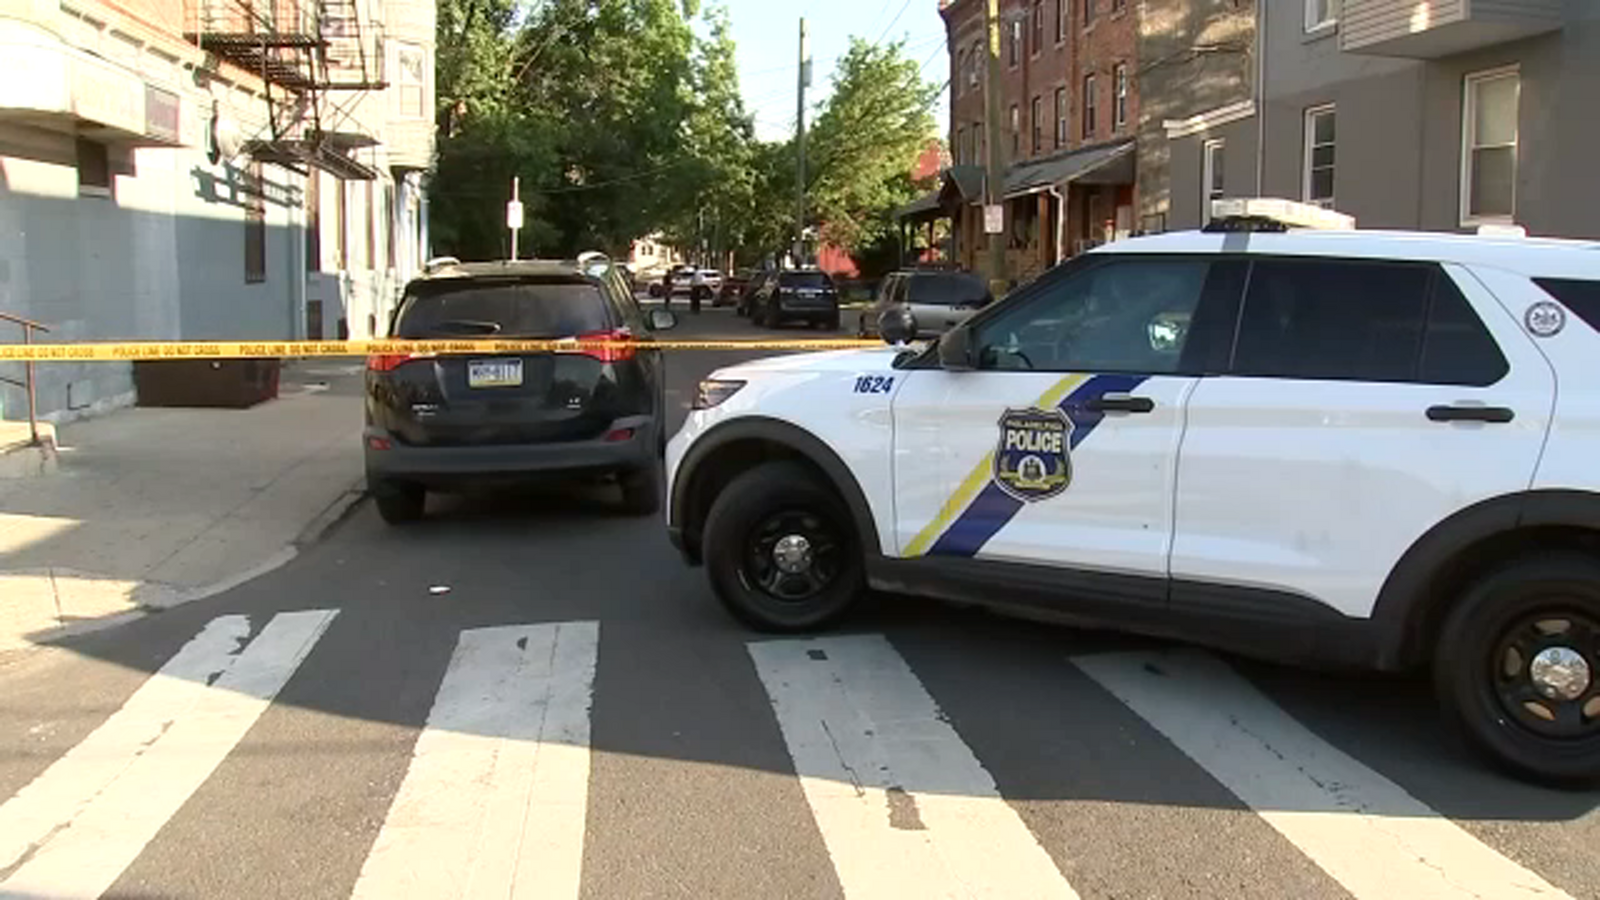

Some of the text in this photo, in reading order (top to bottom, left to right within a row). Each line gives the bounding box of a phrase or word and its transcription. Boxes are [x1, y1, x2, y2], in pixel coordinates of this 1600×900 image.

[177, 345, 191, 355] NOT
[239, 345, 266, 355] POLICE
[269, 345, 286, 355] LINE
[303, 344, 318, 353] NOT
[853, 376, 894, 393] 1624
[1006, 429, 1062, 453] POLICE
